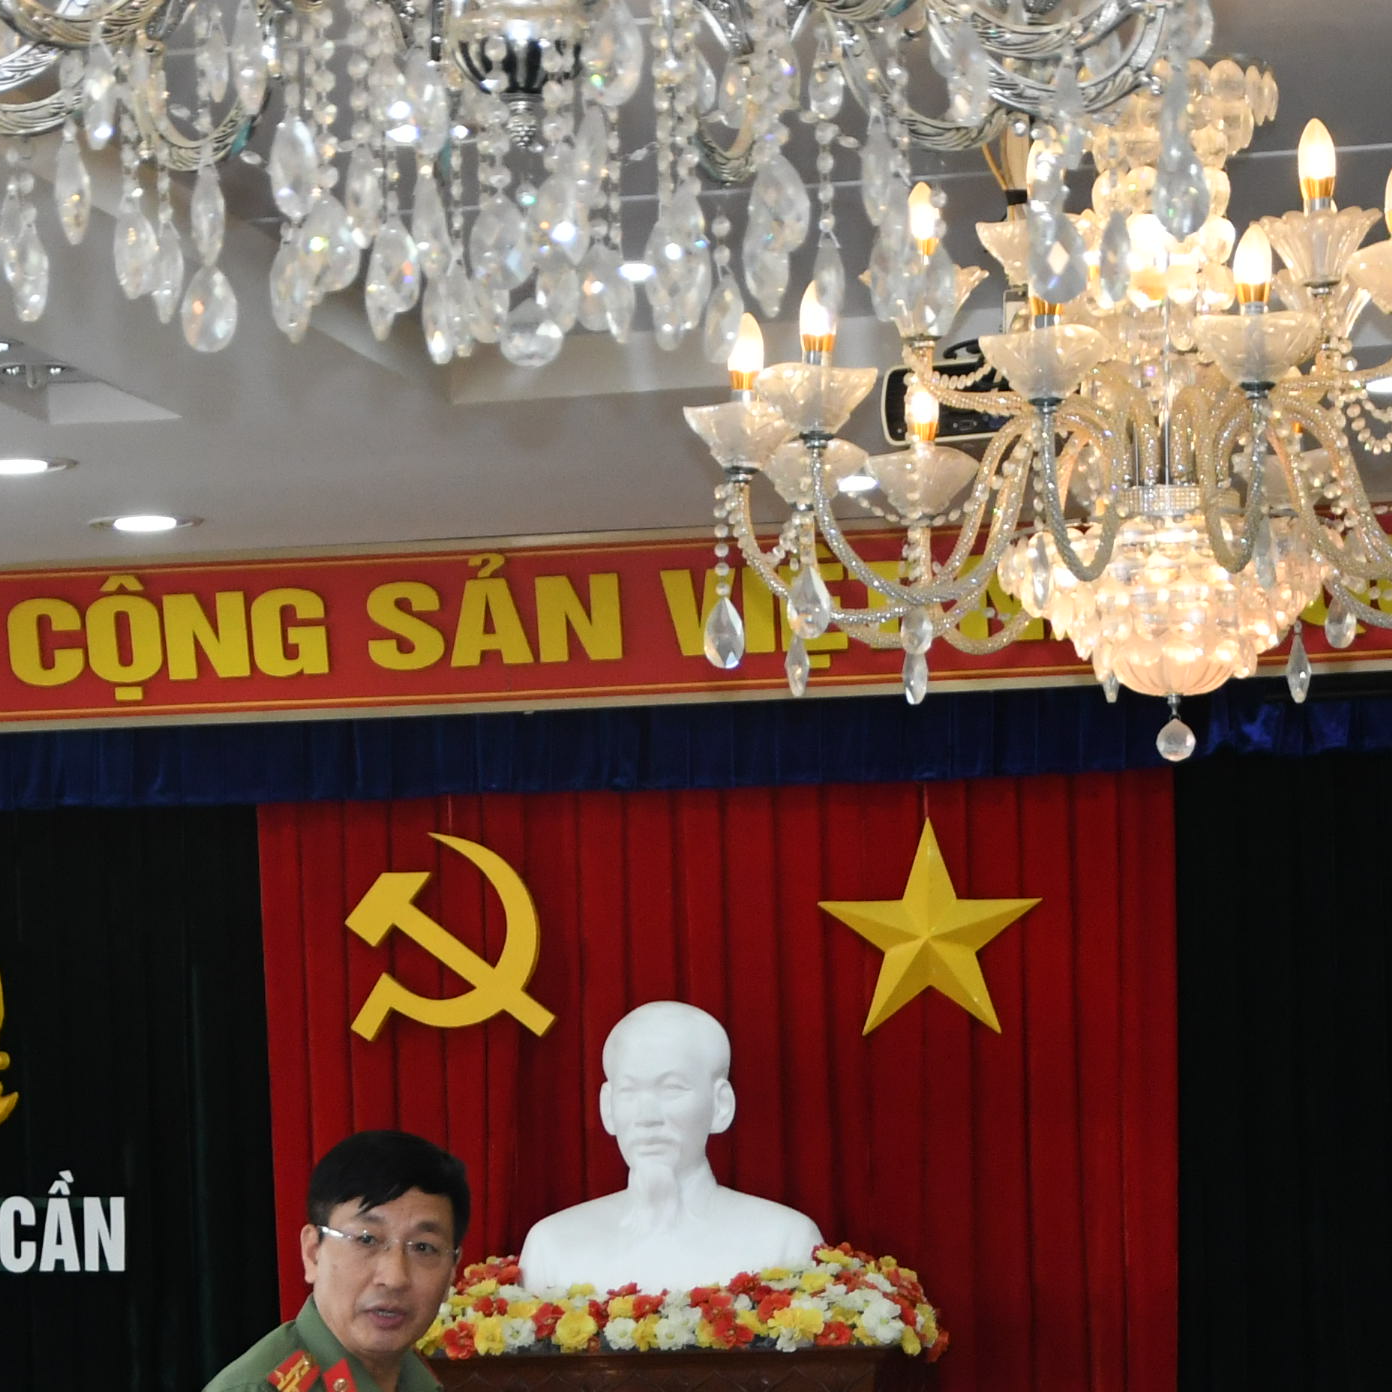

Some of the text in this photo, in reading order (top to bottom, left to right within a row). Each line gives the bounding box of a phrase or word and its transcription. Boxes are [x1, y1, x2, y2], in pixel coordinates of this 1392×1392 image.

[8, 575, 329, 701] CỘNG
[366, 553, 622, 670] SẢN
[0, 1170, 125, 1273] CẦN
